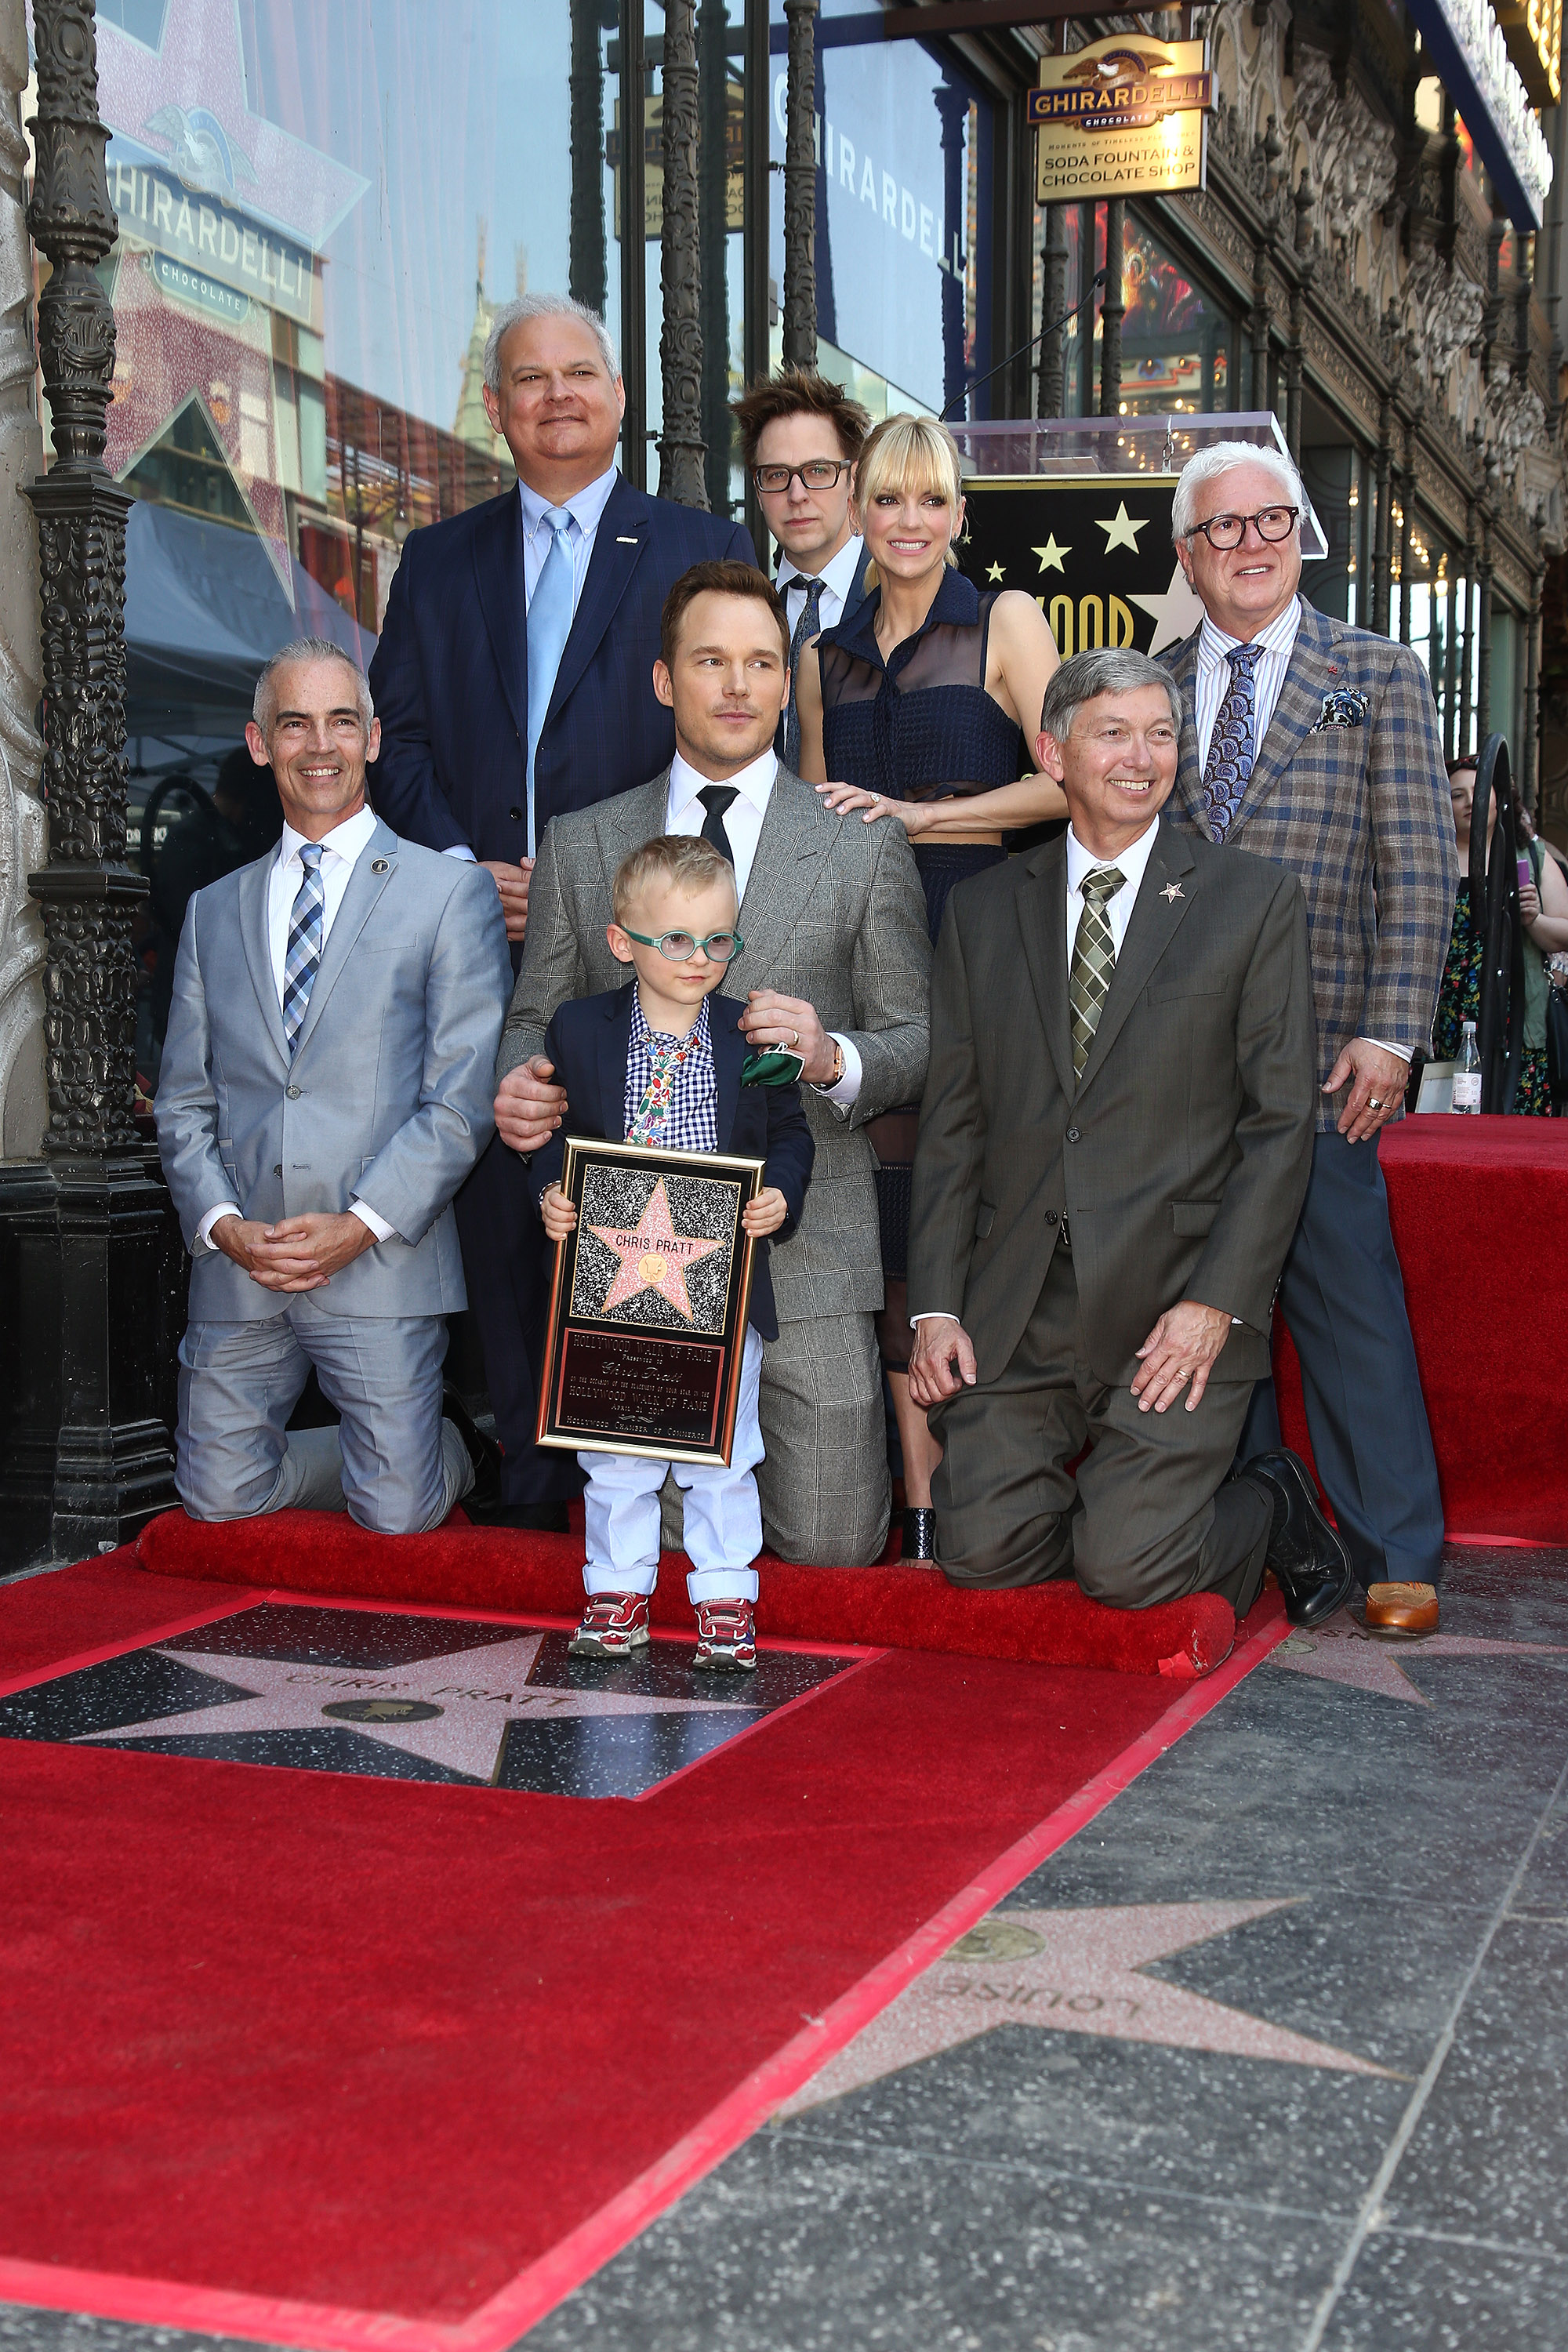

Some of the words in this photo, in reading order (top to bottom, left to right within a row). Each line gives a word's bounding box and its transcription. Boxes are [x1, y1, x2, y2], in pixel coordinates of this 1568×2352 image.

[1034, 79, 1204, 114] GHIRARDELLI
[1085, 114, 1149, 128] CHOCOLATE
[1048, 142, 1087, 151] MOMENTS
[1104, 136, 1144, 146] TIMELESS
[1147, 131, 1196, 143] PLERES
[1044, 156, 1090, 170] SODA
[1093, 146, 1178, 165] FOUNTAIN
[1182, 144, 1194, 156] &
[1042, 166, 1145, 187] CHOCOLATE
[1149, 162, 1196, 177] SHOP
[107, 158, 304, 299] HIRARDELLI
[161, 263, 241, 312] CHOCOLATE
[615, 1234, 651, 1250] CHRIS
[655, 1239, 694, 1255] PRATT
[573, 1334, 630, 1352] HOLLYWOOD
[636, 1341, 664, 1357] WALK
[670, 1346, 681, 1359] OF
[686, 1348, 713, 1363] FAME
[601, 1361, 639, 1377] Chris
[641, 1367, 683, 1383] Pratt
[569, 1385, 626, 1402] HOLLYWOOD
[632, 1392, 659, 1406] WALK
[665, 1397, 677, 1408] OF
[682, 1399, 708, 1412] FAME
[566, 1415, 609, 1428] HOLLYWOOD
[615, 1421, 648, 1433] CHAMBER
[667, 1427, 706, 1440] COMMERCE
[285, 1674, 410, 1692] CHRIS
[430, 1686, 577, 1708] PRATT
[934, 1976, 1142, 2020] LOUISE
